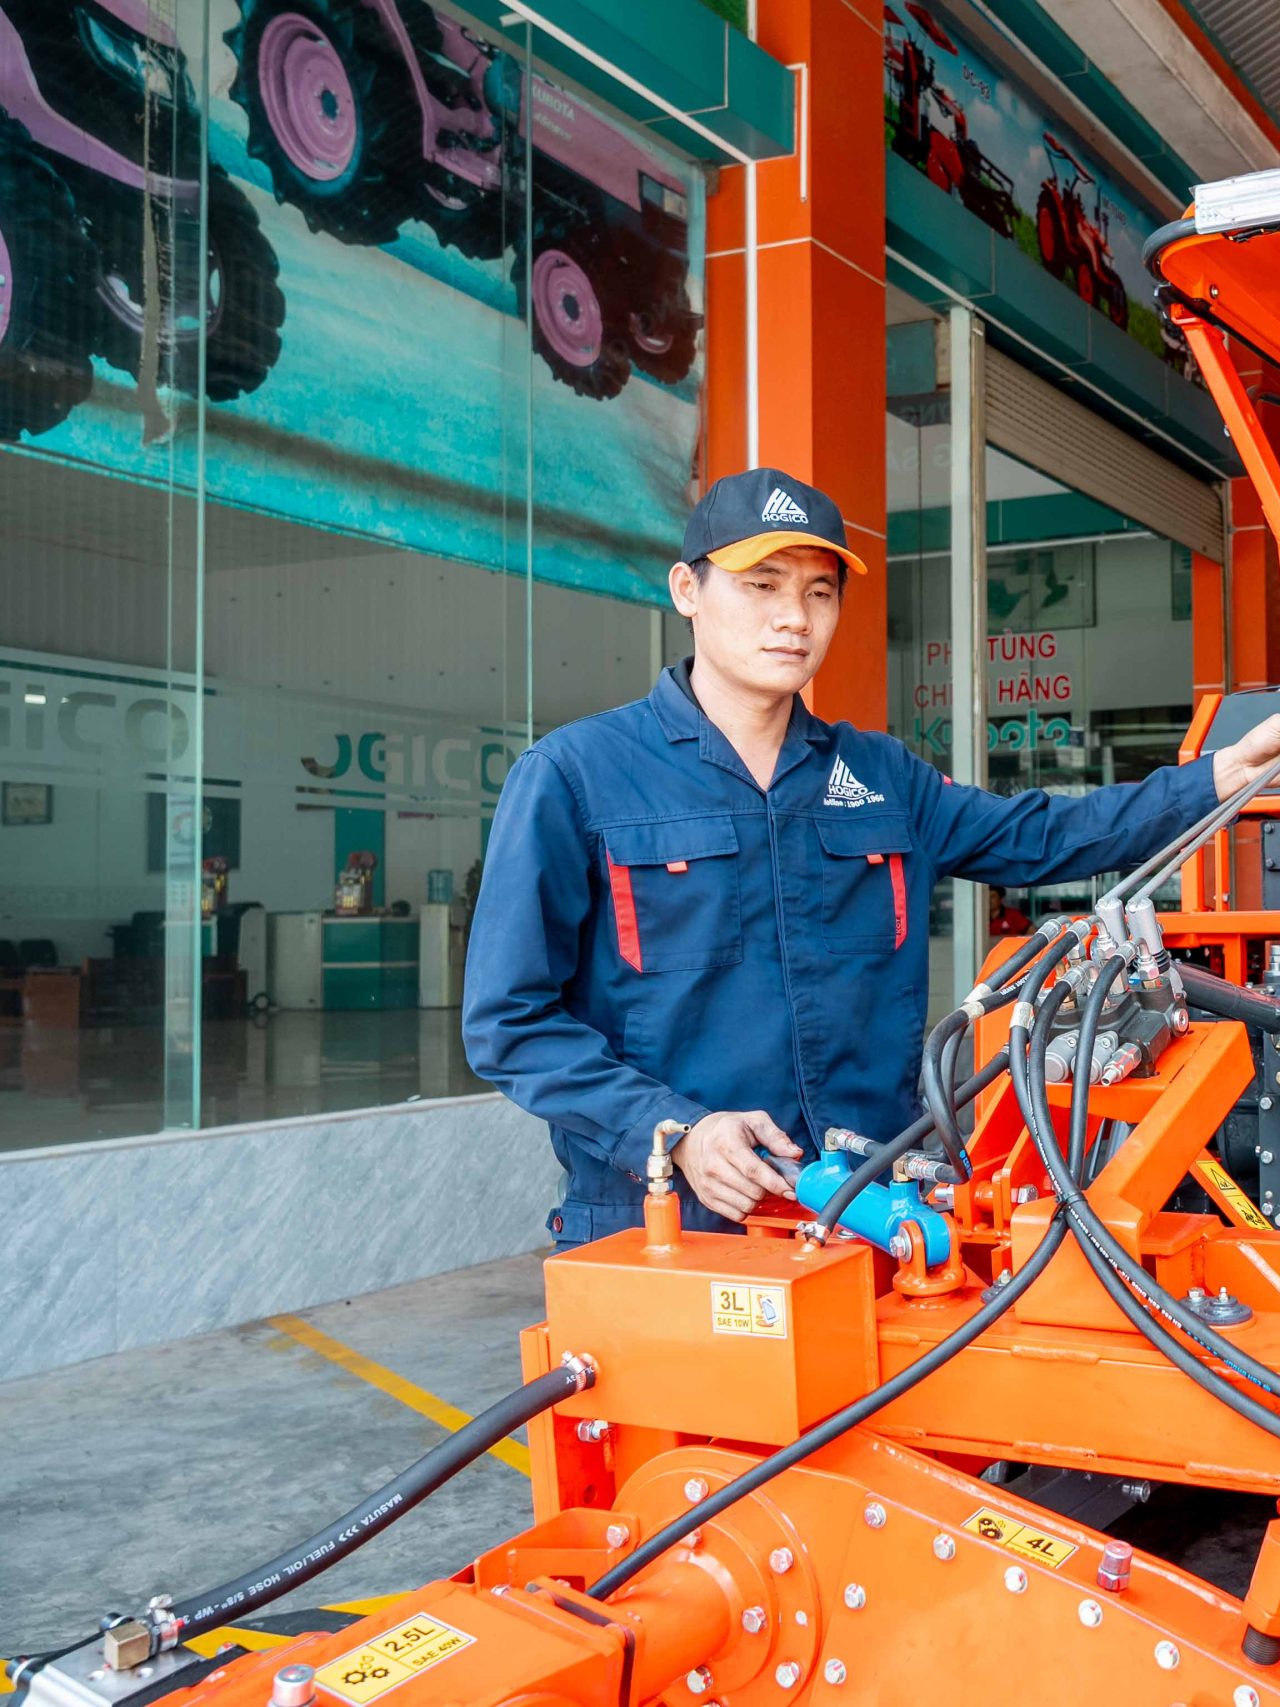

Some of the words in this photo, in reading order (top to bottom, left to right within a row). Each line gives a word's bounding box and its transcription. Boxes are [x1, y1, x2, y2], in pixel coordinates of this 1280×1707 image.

[986, 627, 1057, 663] TÙNG
[998, 672, 1072, 704] HÃNG
[720, 1290, 744, 1312] 3L
[717, 1316, 732, 1327] SAE
[734, 1318, 749, 1329] 10W
[360, 1493, 404, 1527] MASUTA
[282, 1540, 336, 1576] FUEL/OIL
[1026, 1538, 1055, 1557] 4L
[247, 1572, 281, 1596] HOSE
[384, 1626, 436, 1653] 2,5L
